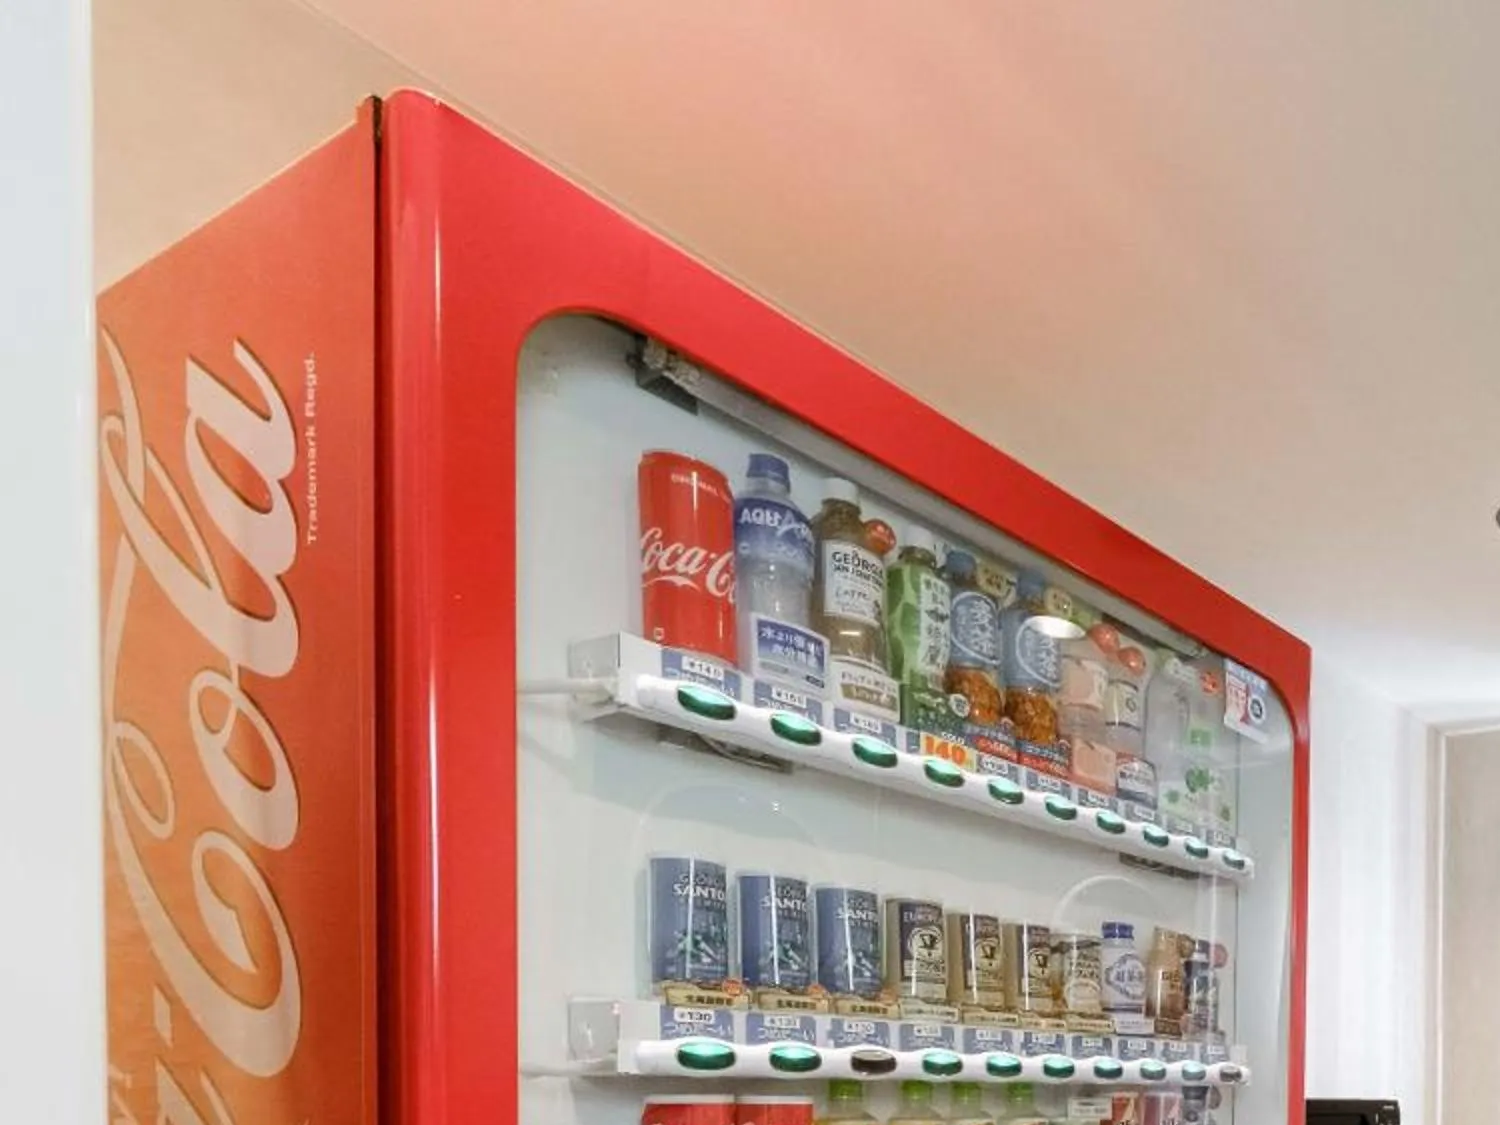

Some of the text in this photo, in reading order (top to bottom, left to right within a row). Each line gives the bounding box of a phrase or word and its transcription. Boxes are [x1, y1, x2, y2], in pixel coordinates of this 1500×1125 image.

[306, 424, 318, 544] Trademark
[640, 526, 735, 604] Coca-C
[673, 884, 726, 901] SANTO
